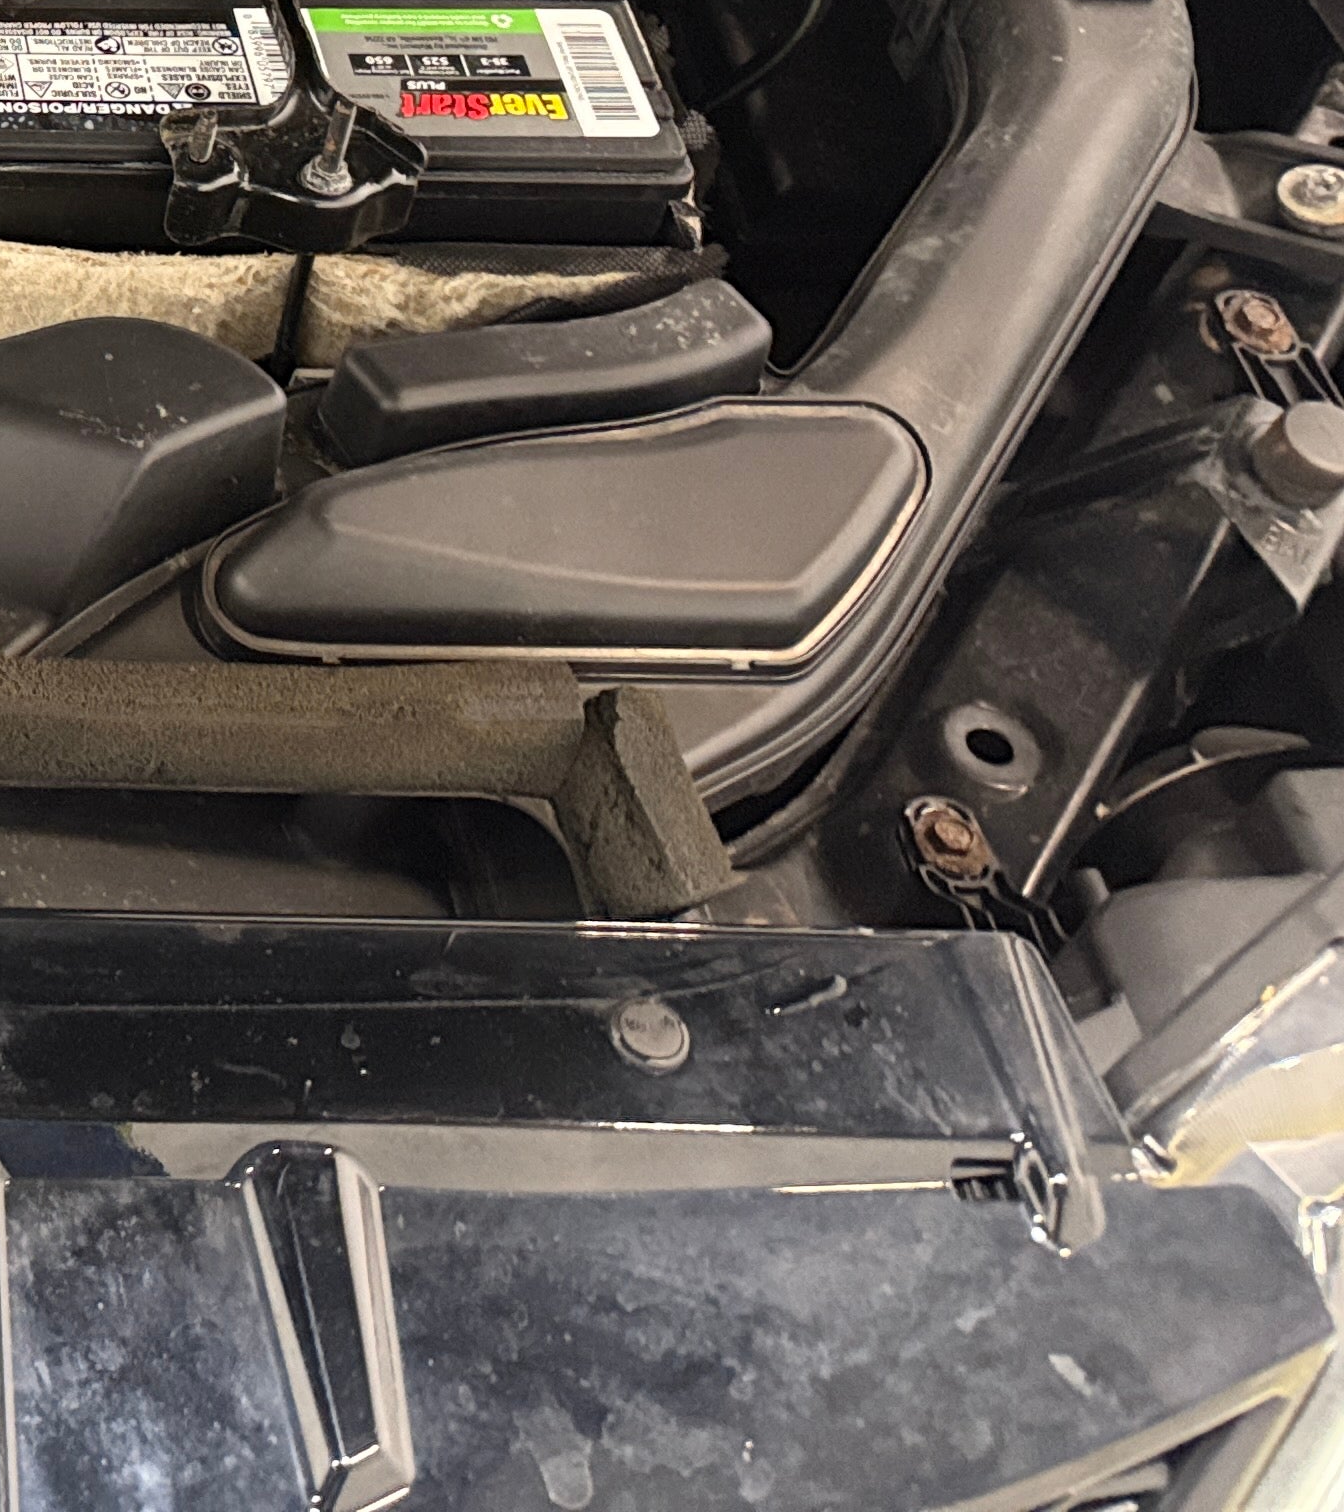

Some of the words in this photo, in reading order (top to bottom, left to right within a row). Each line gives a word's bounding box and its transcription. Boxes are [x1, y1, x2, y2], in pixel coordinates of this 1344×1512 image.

[364, 55, 393, 65] 650
[421, 56, 449, 66] 525
[195, 74, 248, 82] EXPLOSIVE
[406, 80, 446, 90] PLUS
[50, 89, 97, 98] SULFURIC
[218, 91, 252, 99] SHIELD
[400, 91, 569, 121] EverStart
